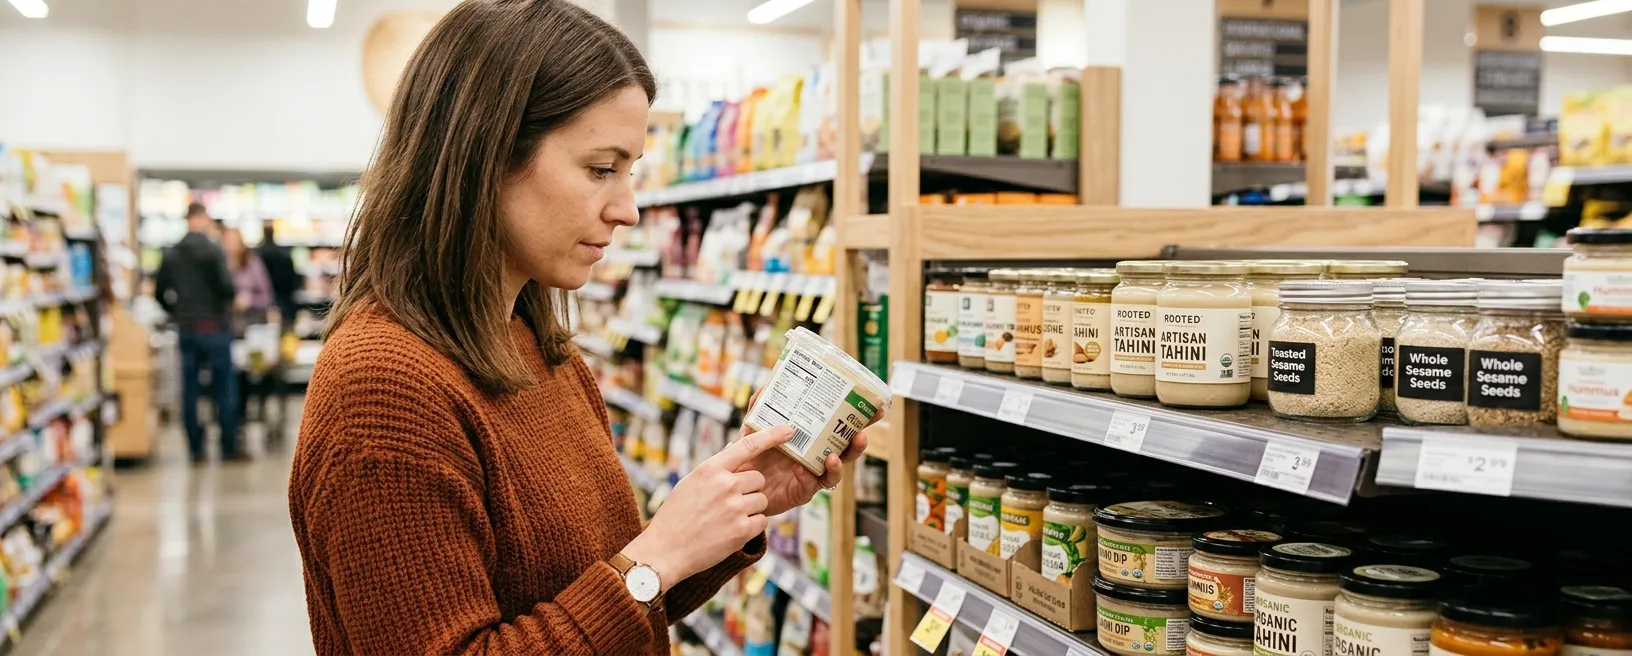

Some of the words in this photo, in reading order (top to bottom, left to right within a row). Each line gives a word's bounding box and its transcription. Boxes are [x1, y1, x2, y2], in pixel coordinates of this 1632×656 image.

[1117, 310, 1151, 319] ROOTED
[1164, 314, 1201, 324] ROOTED
[1114, 326, 1156, 338] ARTISAN
[1160, 331, 1206, 344] ARTISAN
[1114, 338, 1156, 354] TAHINI
[1160, 344, 1206, 361] TAHINI
[1271, 359, 1305, 371] Sesame
[1409, 353, 1448, 365] Whole
[1480, 357, 1524, 371] Whole
[1273, 371, 1300, 383] Seeds
[1405, 365, 1452, 378] Sesame
[1476, 371, 1528, 385] Sesame
[1410, 377, 1447, 390] Seeds
[1481, 384, 1522, 398] Seeds
